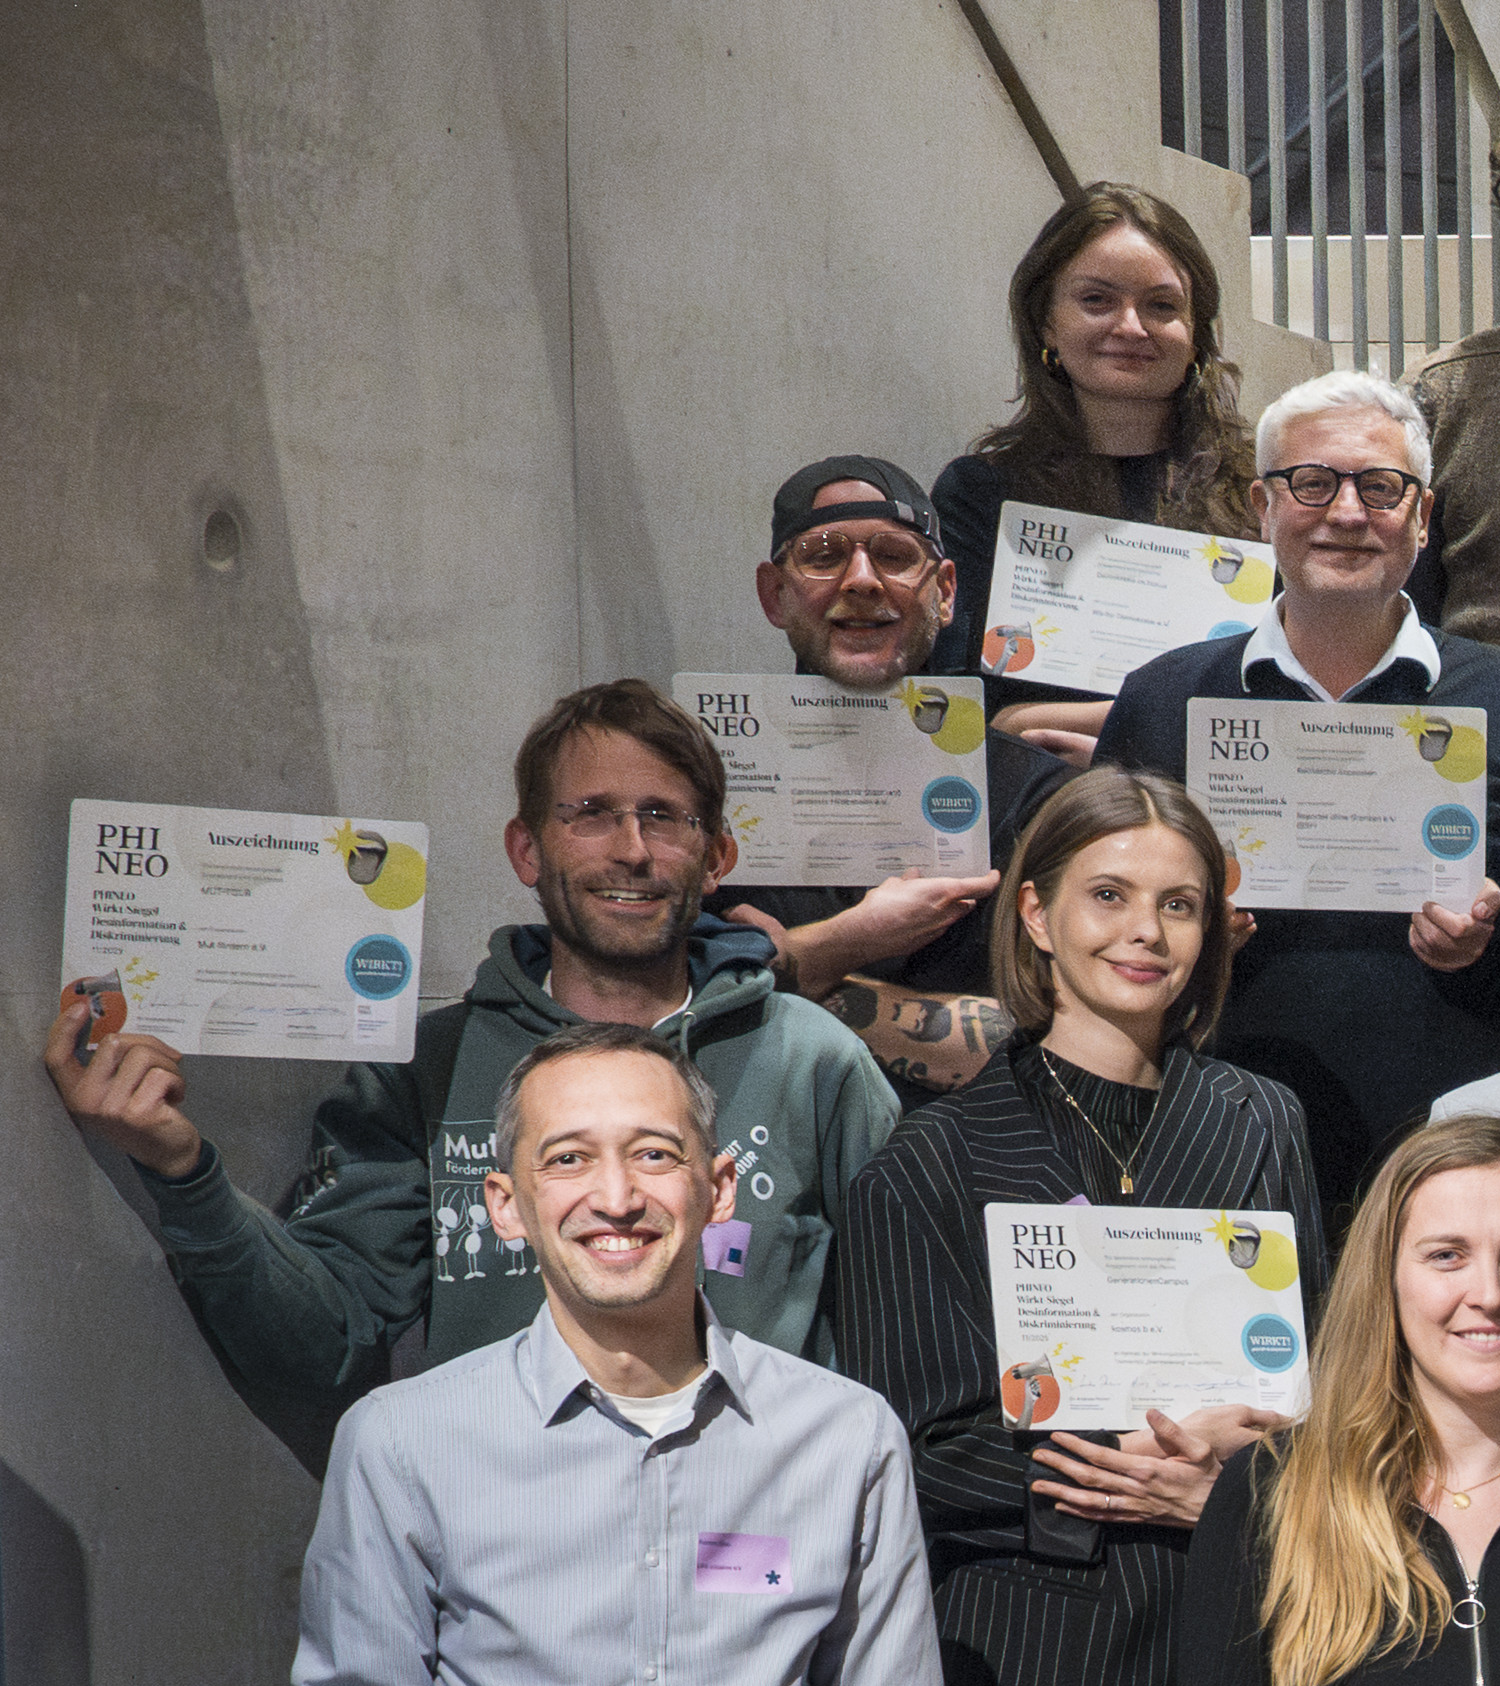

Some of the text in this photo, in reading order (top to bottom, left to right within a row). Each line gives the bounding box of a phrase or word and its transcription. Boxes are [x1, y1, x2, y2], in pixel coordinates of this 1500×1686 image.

[1020, 519, 1067, 542] PHI
[1018, 537, 1073, 561] NEO
[696, 693, 749, 713] PHI
[698, 716, 759, 736] NEO
[1210, 718, 1260, 738] PHI
[1210, 740, 1269, 760] NEO
[97, 824, 159, 850] PHI
[96, 850, 168, 876] NEO
[445, 1132, 497, 1160] Mut
[717, 1140, 742, 1157] UT
[735, 1151, 759, 1179] OUR
[1011, 1224, 1065, 1245] PHI
[1013, 1248, 1076, 1269] NEO
